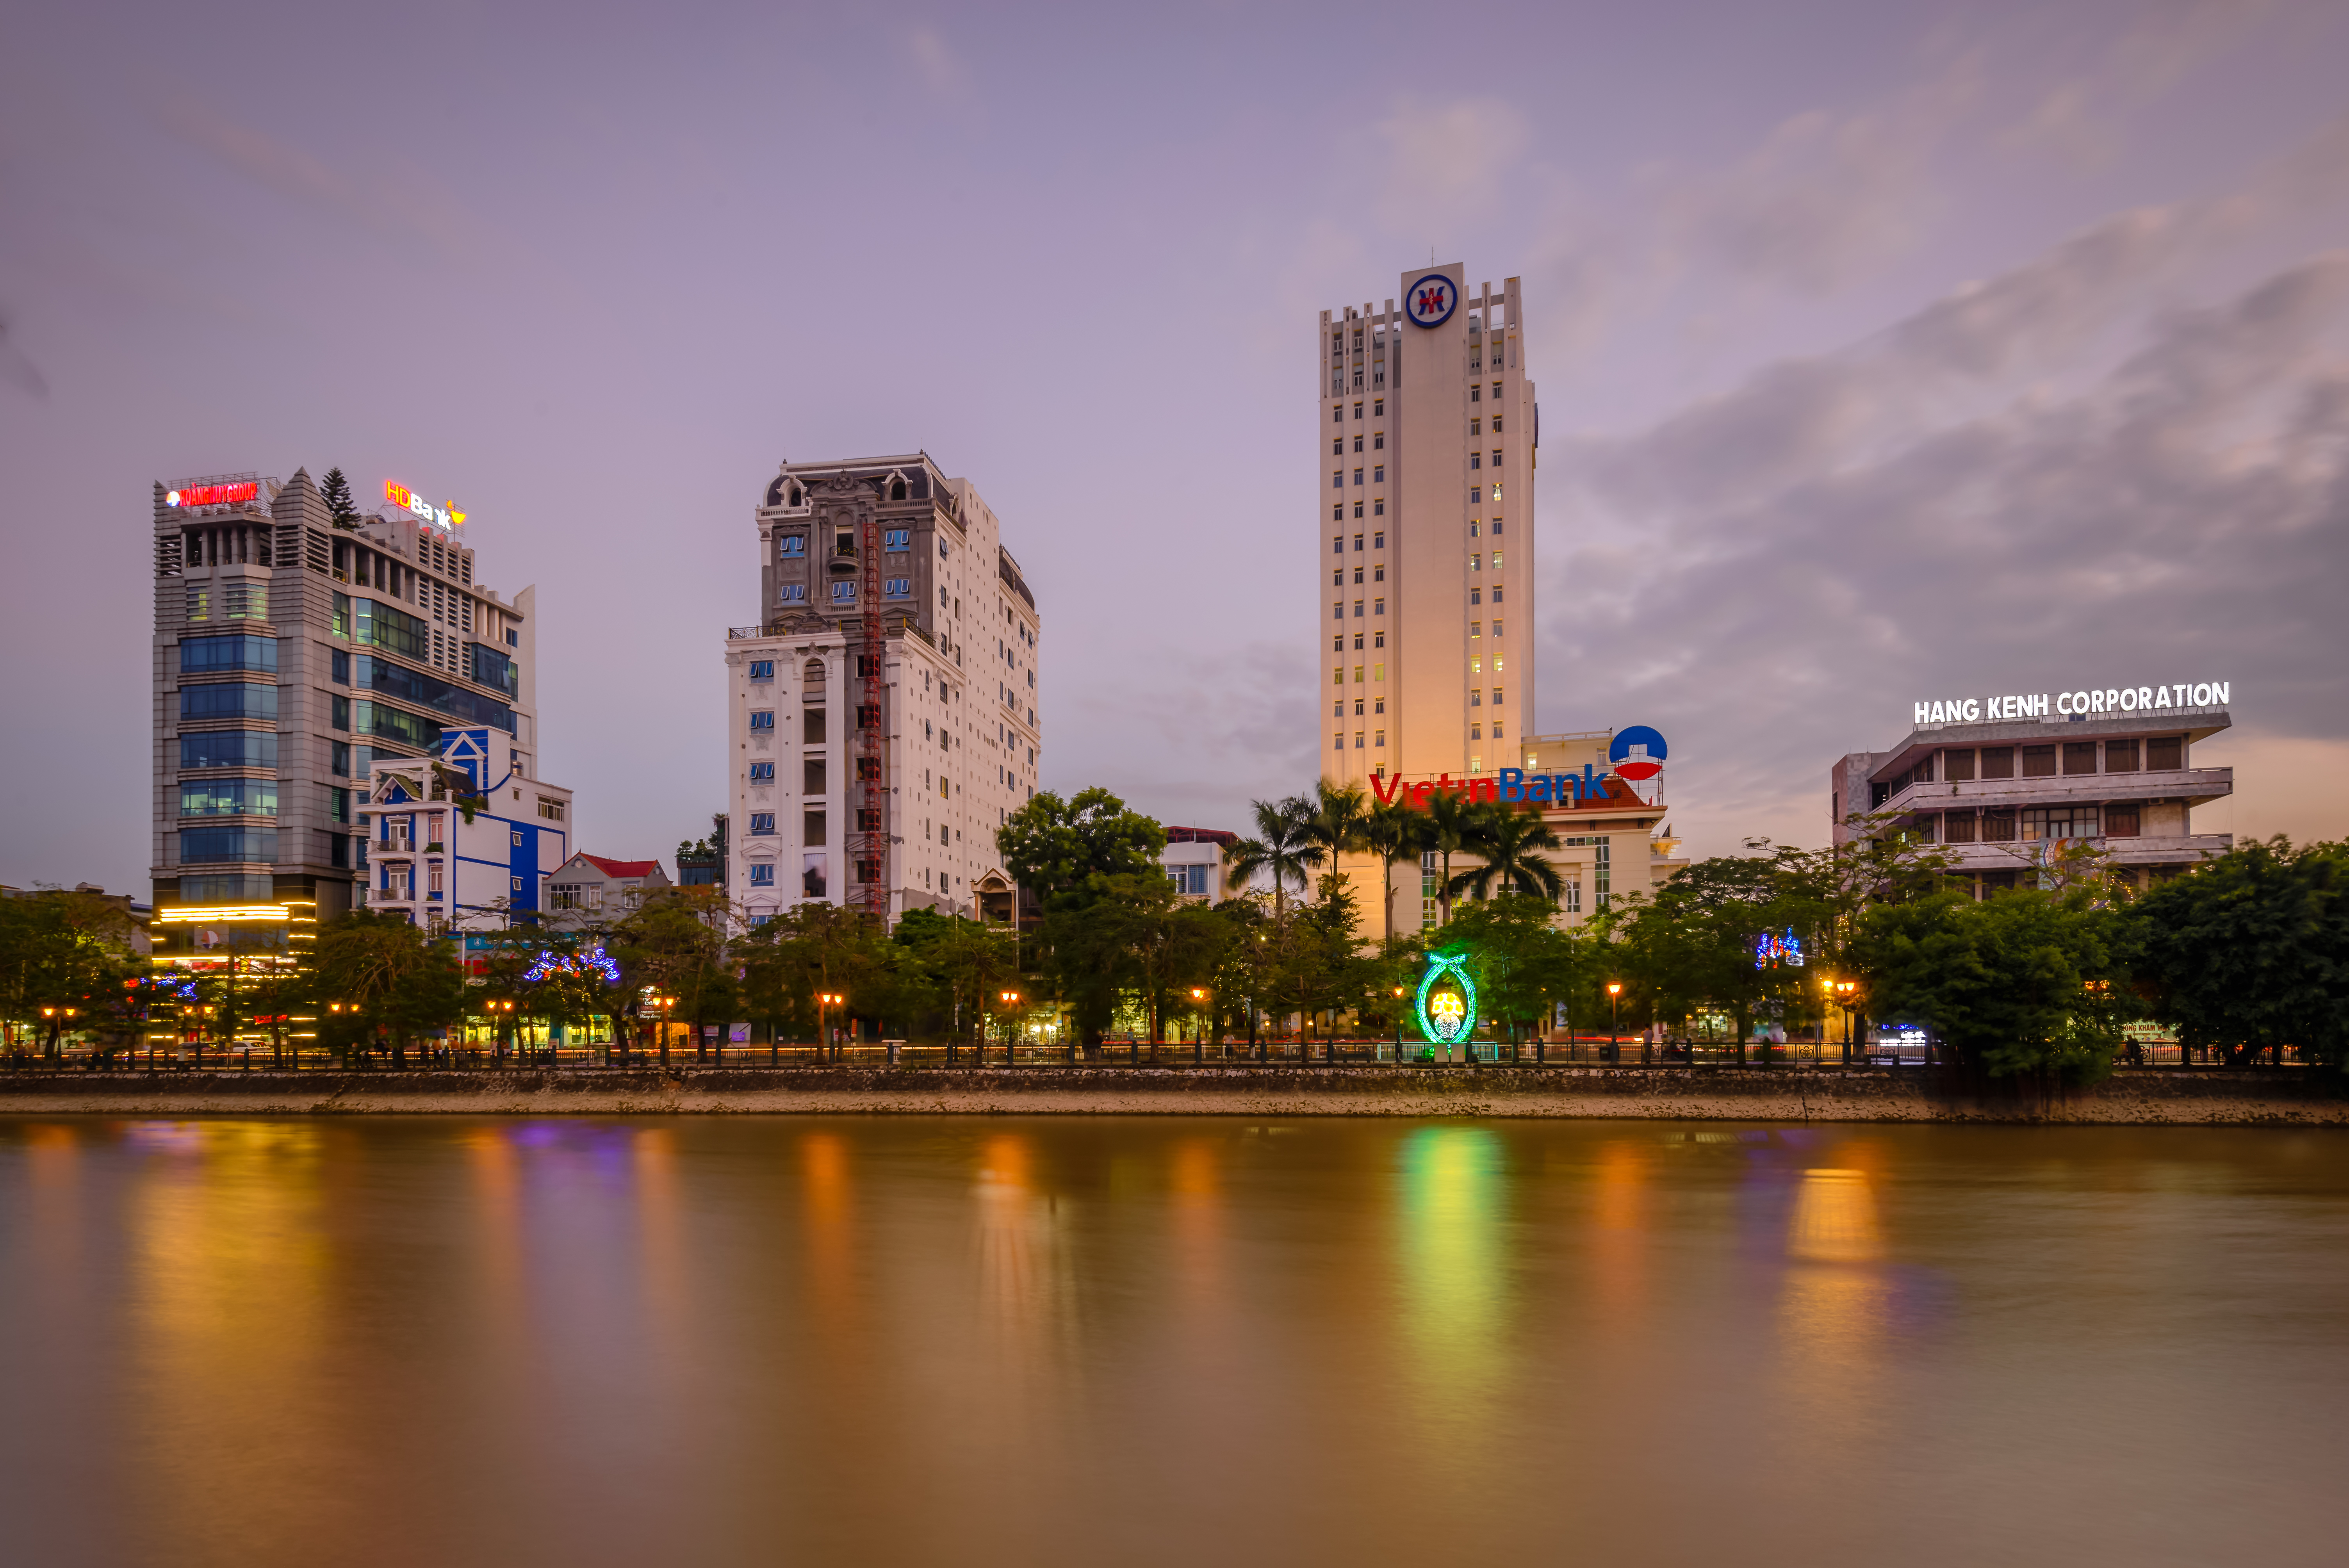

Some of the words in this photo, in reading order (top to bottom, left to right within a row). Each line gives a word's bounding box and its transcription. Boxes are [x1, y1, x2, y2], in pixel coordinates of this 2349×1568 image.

[387, 481, 451, 530] HDBank
[1915, 698, 1980, 723] HANG
[1988, 693, 2048, 719] KENH
[2057, 681, 2229, 715] CORPORATION
